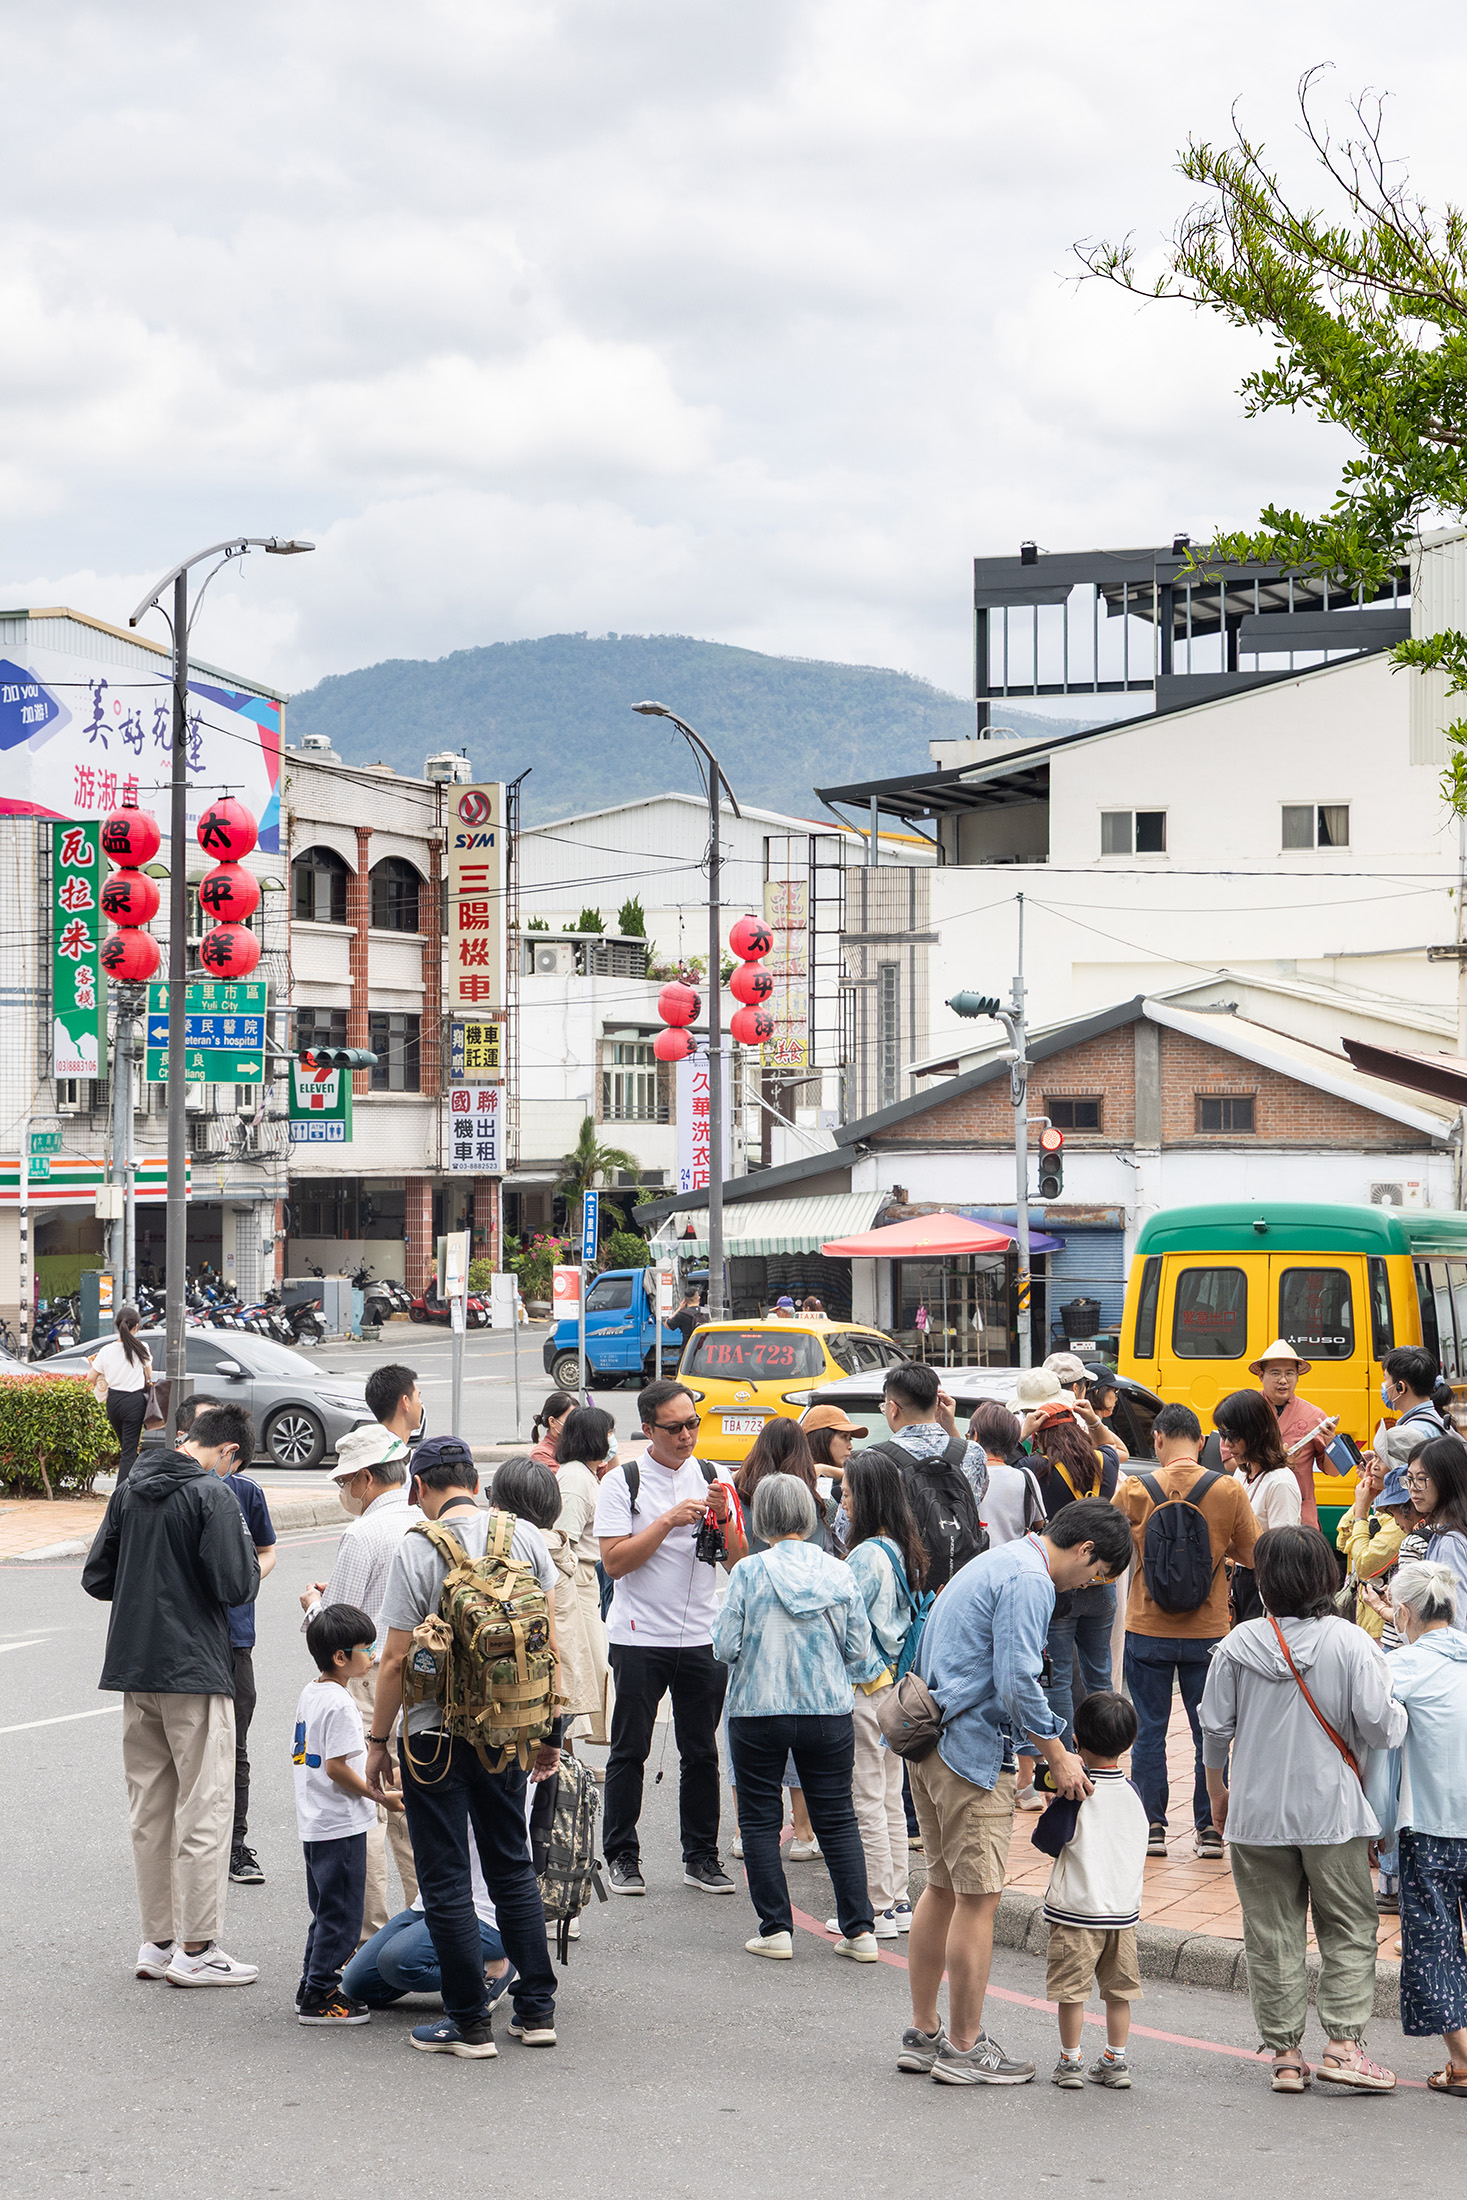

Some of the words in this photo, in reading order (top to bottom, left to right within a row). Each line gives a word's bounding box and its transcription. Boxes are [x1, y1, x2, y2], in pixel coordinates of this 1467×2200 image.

[2, 685, 20, 703] 加
[74, 764, 139, 811] 游淑貞
[454, 833, 495, 850] SYM
[59, 828, 94, 959] 瓦拉米
[459, 864, 490, 1002] 三陽機車
[76, 966, 96, 1008] 客棧
[201, 1000, 218, 1010] Yuli
[221, 1000, 239, 1013] City
[184, 1035, 221, 1046] eteran's
[223, 1035, 258, 1048] hospital
[466, 1025, 499, 1045] 機車
[466, 1047, 499, 1068] 託運
[775, 1040, 803, 1064] 美食
[56, 1059, 97, 1072] (03)8883106
[158, 1068, 206, 1081] Chliang
[451, 1089, 499, 1114] 國聯
[459, 1163, 498, 1171] 03-8882523
[680, 1168, 691, 1180] 24
[1183, 1310, 1236, 1327] 緊急出口
[1298, 1336, 1346, 1344] FUSO
[704, 1344, 795, 1366] TBA-723
